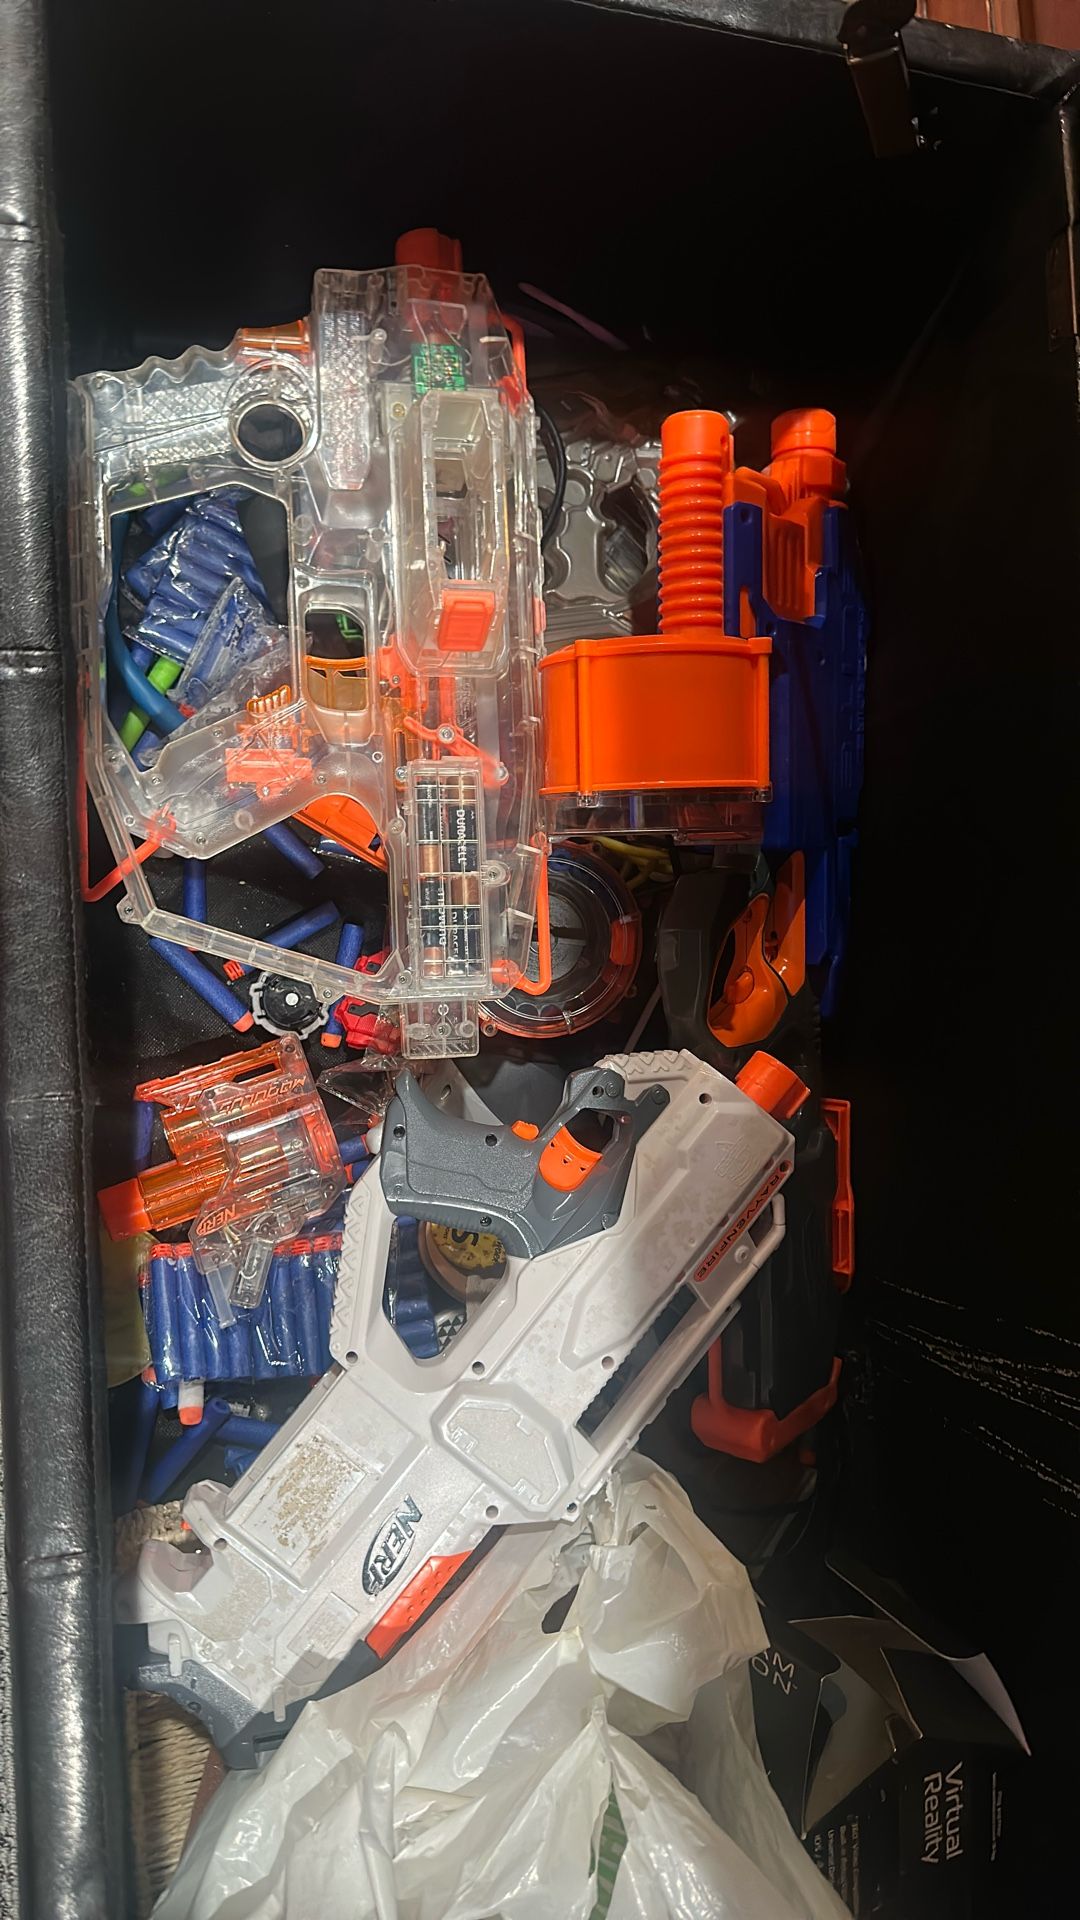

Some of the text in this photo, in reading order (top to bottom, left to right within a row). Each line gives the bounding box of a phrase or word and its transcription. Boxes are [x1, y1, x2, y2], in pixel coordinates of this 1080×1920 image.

[456, 809, 467, 865] DURACELL
[197, 1203, 236, 1236] NERF
[698, 1175, 780, 1278] RAYVENFIRE
[367, 1493, 423, 1595] NERF
[921, 1771, 943, 1864] Reality
[945, 1760, 964, 1861] Virtual
